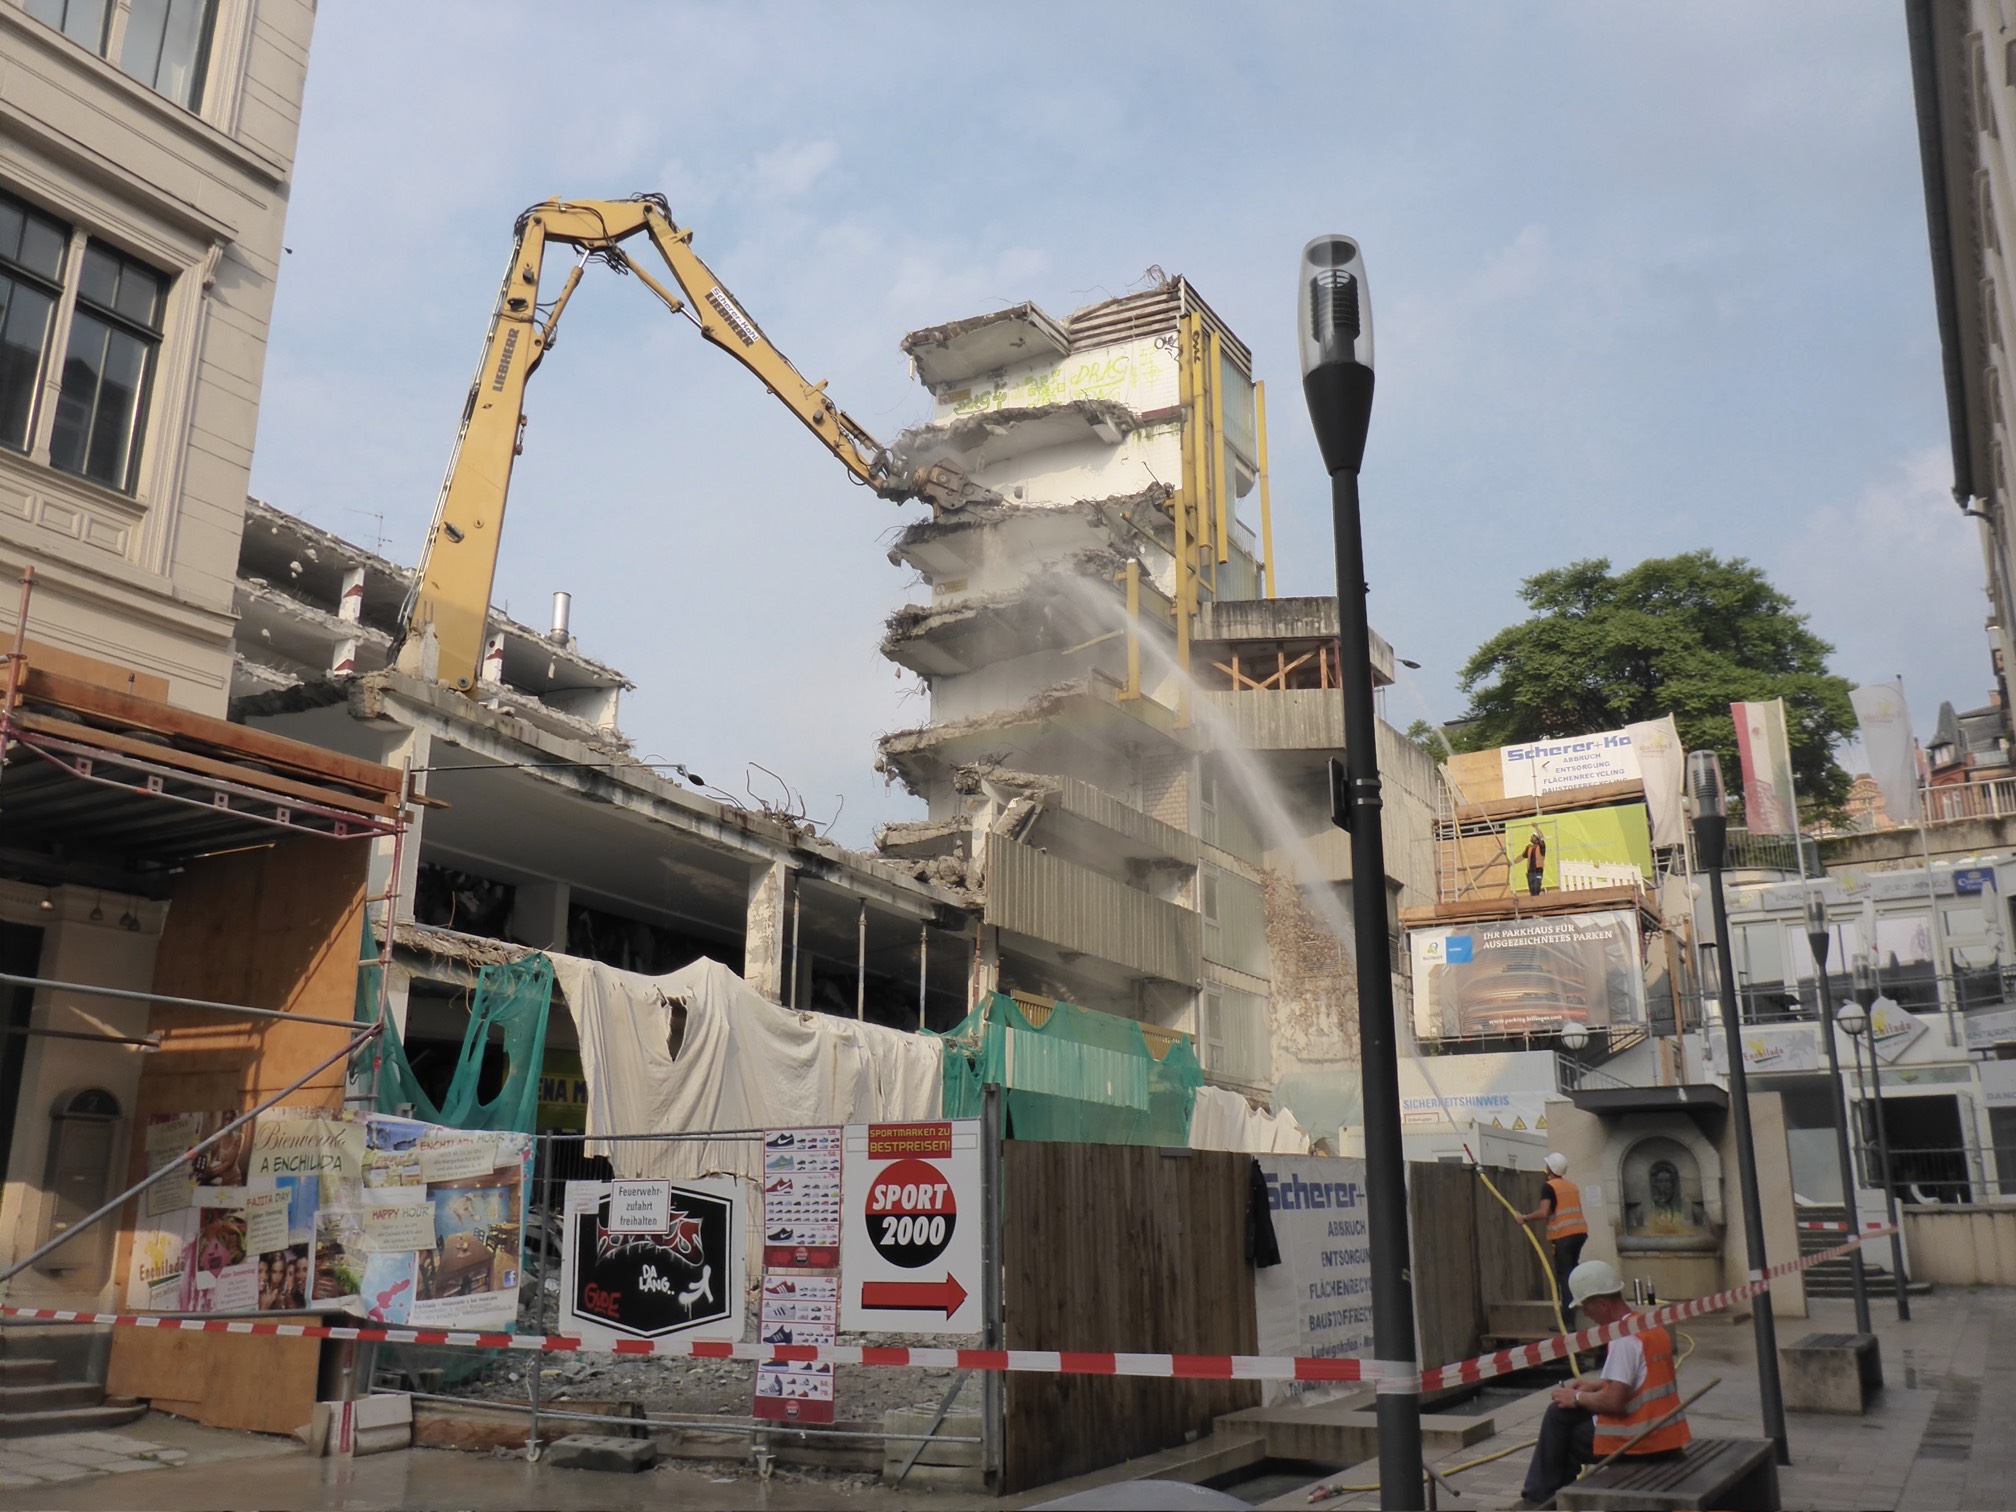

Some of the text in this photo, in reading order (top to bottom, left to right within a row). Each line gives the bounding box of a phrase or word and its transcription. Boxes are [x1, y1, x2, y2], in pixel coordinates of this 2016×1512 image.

[704, 292, 755, 348] LIEBHERR
[492, 328, 520, 392] LIEBHERR
[1563, 753, 1601, 763] ABBRUCH
[1555, 761, 1611, 774] ENTSORGUNG
[1483, 923, 1575, 941] IHR PARKHAUS FÜR
[1483, 930, 1613, 949] AUSGEZEICHNETES PARKEN
[1860, 1021, 1912, 1040] Echilada
[477, 1133, 505, 1144] HOUR
[869, 1127, 951, 1137] SPORTMARKEN ZU
[869, 1140, 951, 1153] BESTPREISEN!
[261, 1157, 269, 1172] A
[618, 1186, 662, 1196] Feuerwehr-
[872, 1184, 948, 1210] SPORT
[247, 1191, 289, 1208] FAJITA DAY
[626, 1201, 653, 1211] zufahrt
[372, 1206, 429, 1220] HAPPY HOUR
[620, 1216, 657, 1226] freihalten
[880, 1216, 946, 1246] 2000
[1328, 1220, 1366, 1237] ABBRUCH
[1321, 1248, 1370, 1267] ENTSORGUN
[643, 1264, 657, 1278] DA
[1309, 1306, 1373, 1331] BAUSTOFFRECY
